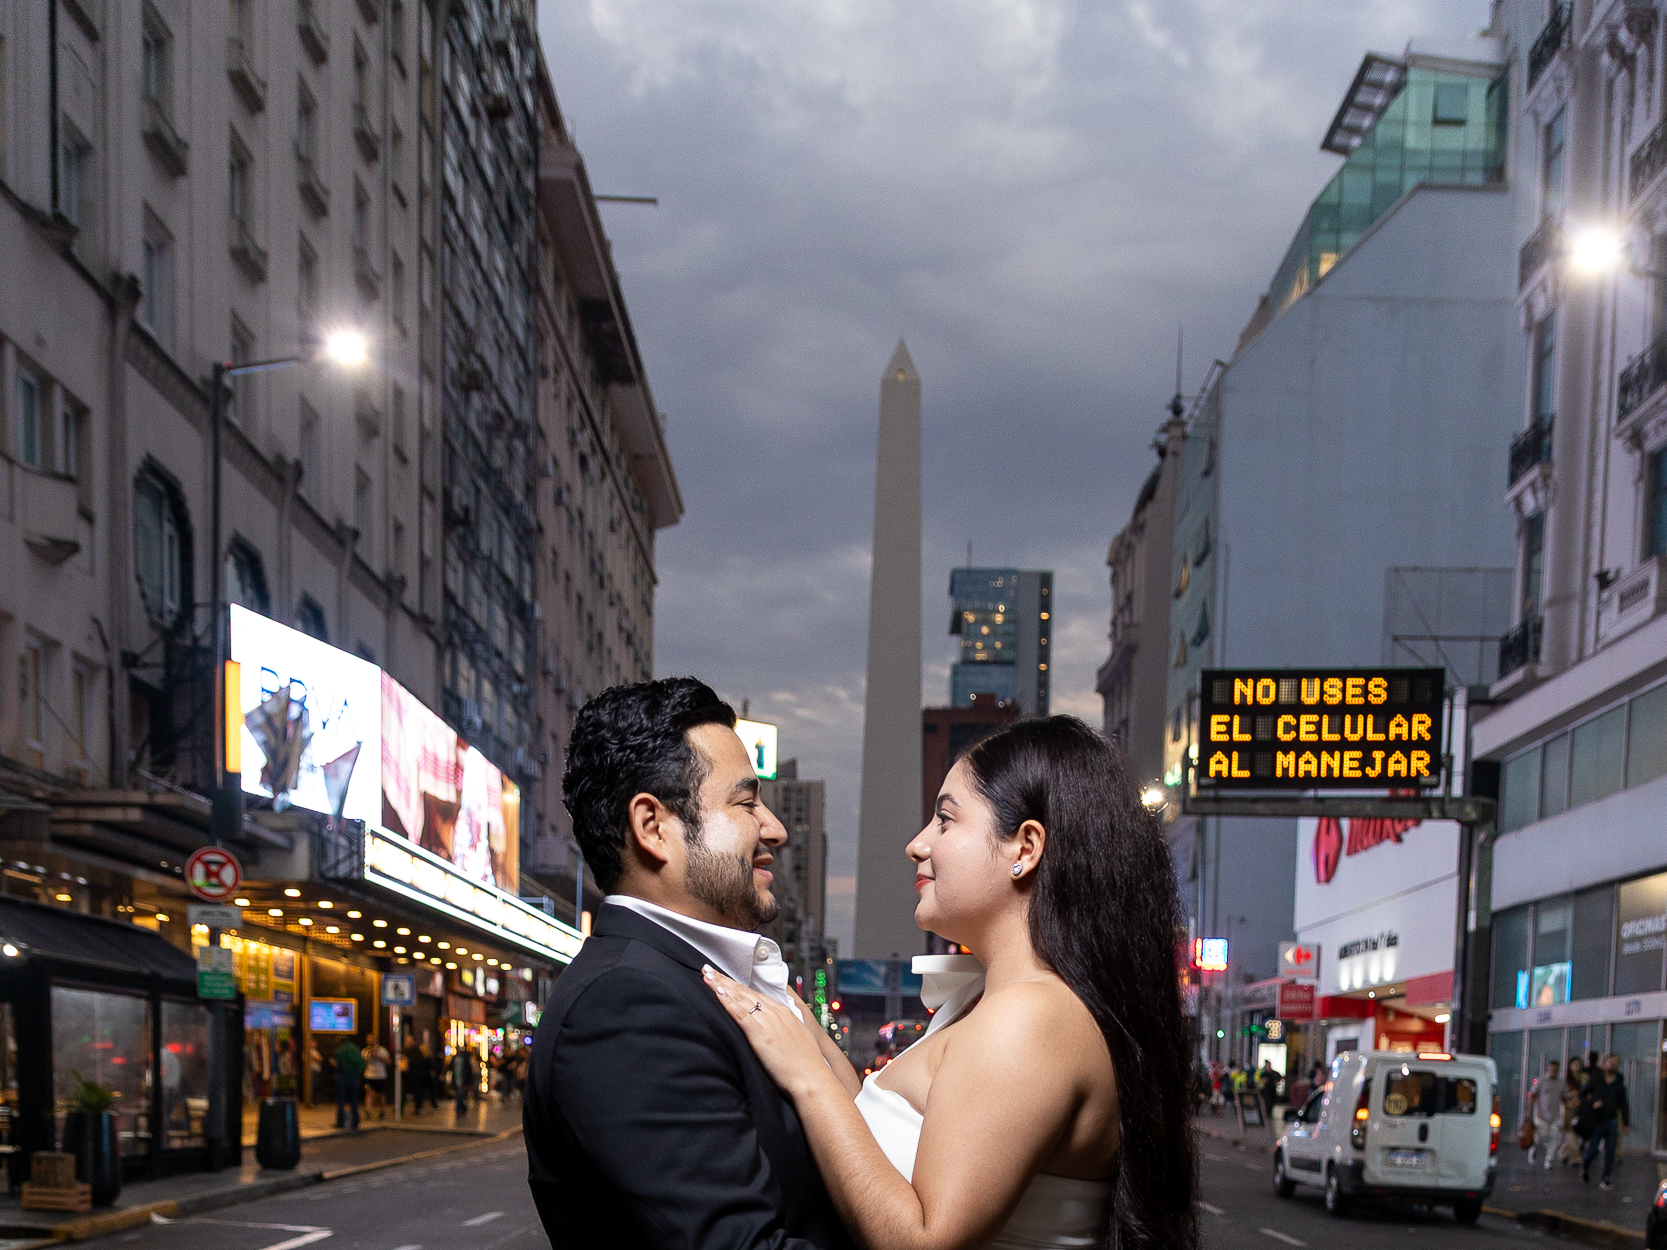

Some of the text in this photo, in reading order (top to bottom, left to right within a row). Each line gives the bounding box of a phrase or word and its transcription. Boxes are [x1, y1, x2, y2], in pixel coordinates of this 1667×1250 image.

[1233, 677, 1388, 706] NO USES
[1210, 713, 1432, 742] EL CELULAR
[1208, 750, 1431, 778] AL MANEJAR
